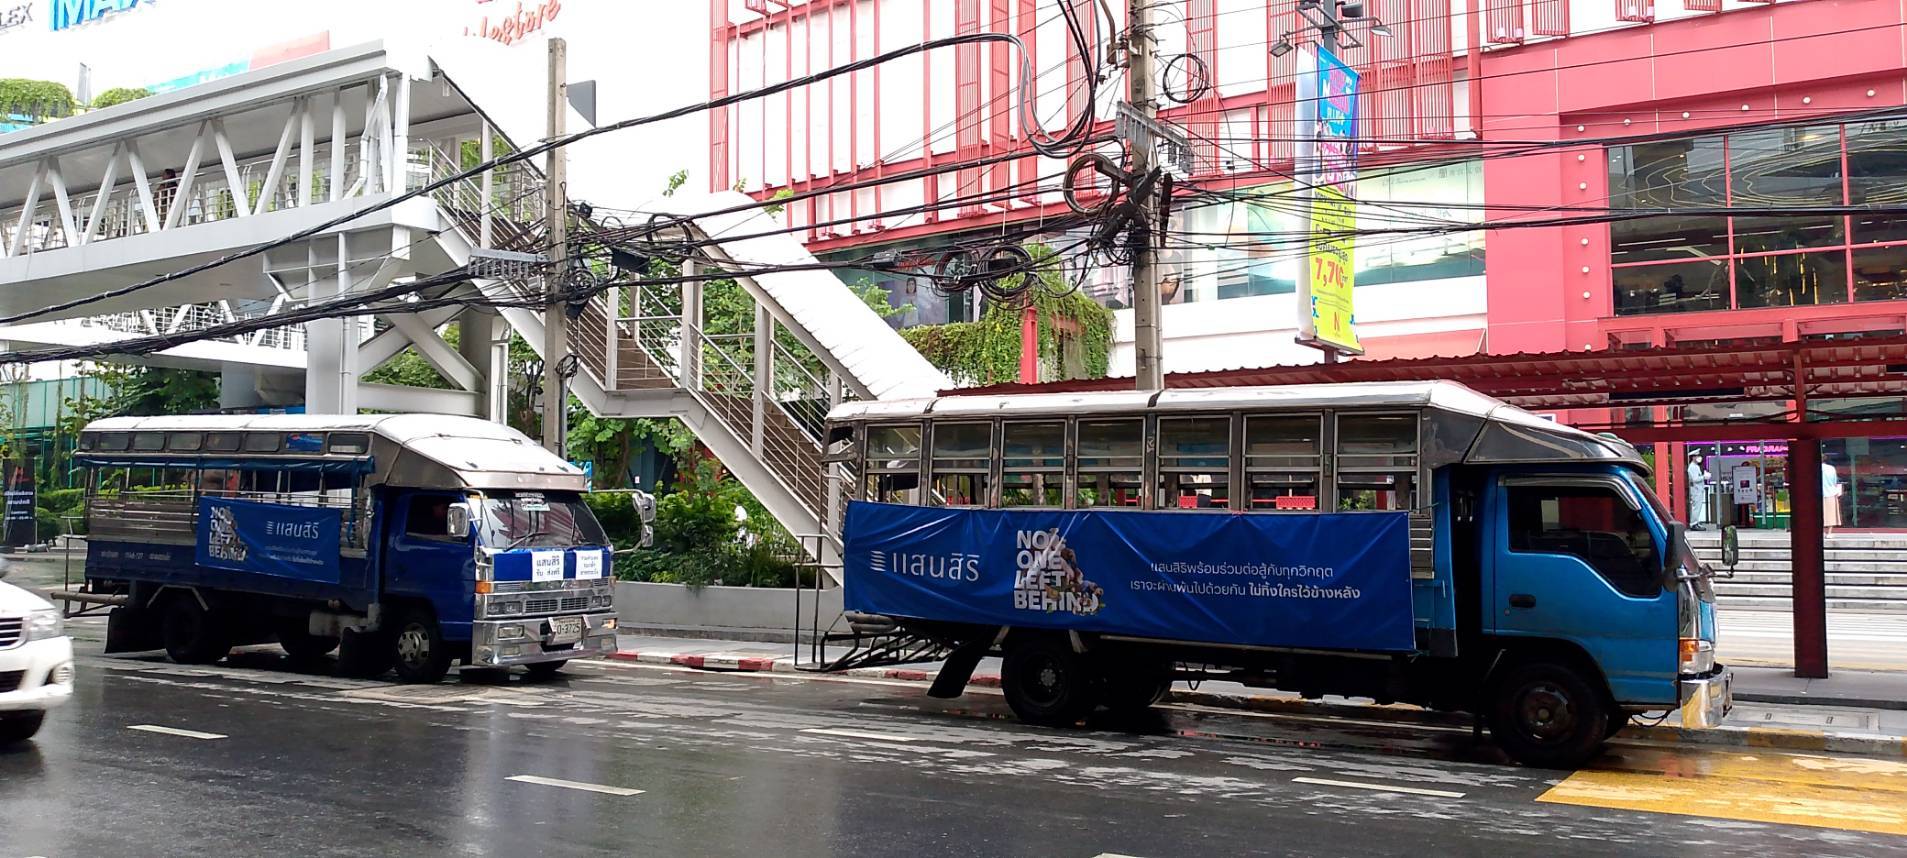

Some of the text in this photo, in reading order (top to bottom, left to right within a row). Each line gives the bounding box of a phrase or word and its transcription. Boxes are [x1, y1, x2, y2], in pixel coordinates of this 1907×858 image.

[49, 0, 156, 31] IMA
[276, 521, 320, 540] แสนสิริ
[1016, 529, 1051, 550] NO
[892, 552, 981, 582] แสนสิริ
[1016, 549, 1063, 570] ONE
[1014, 569, 1066, 590] LEFT
[1150, 561, 1334, 581] แสนสิริพร้อมร่วมต่อสู้กับทุกวิกฤต
[1129, 578, 1361, 599] เราจะผ่านพ้นไปด้วยกัน ไม่ทิ้งใครไว้ข้างหลัง
[1013, 589, 1099, 612] BEHIND
[556, 622, 581, 635] 0-3725
